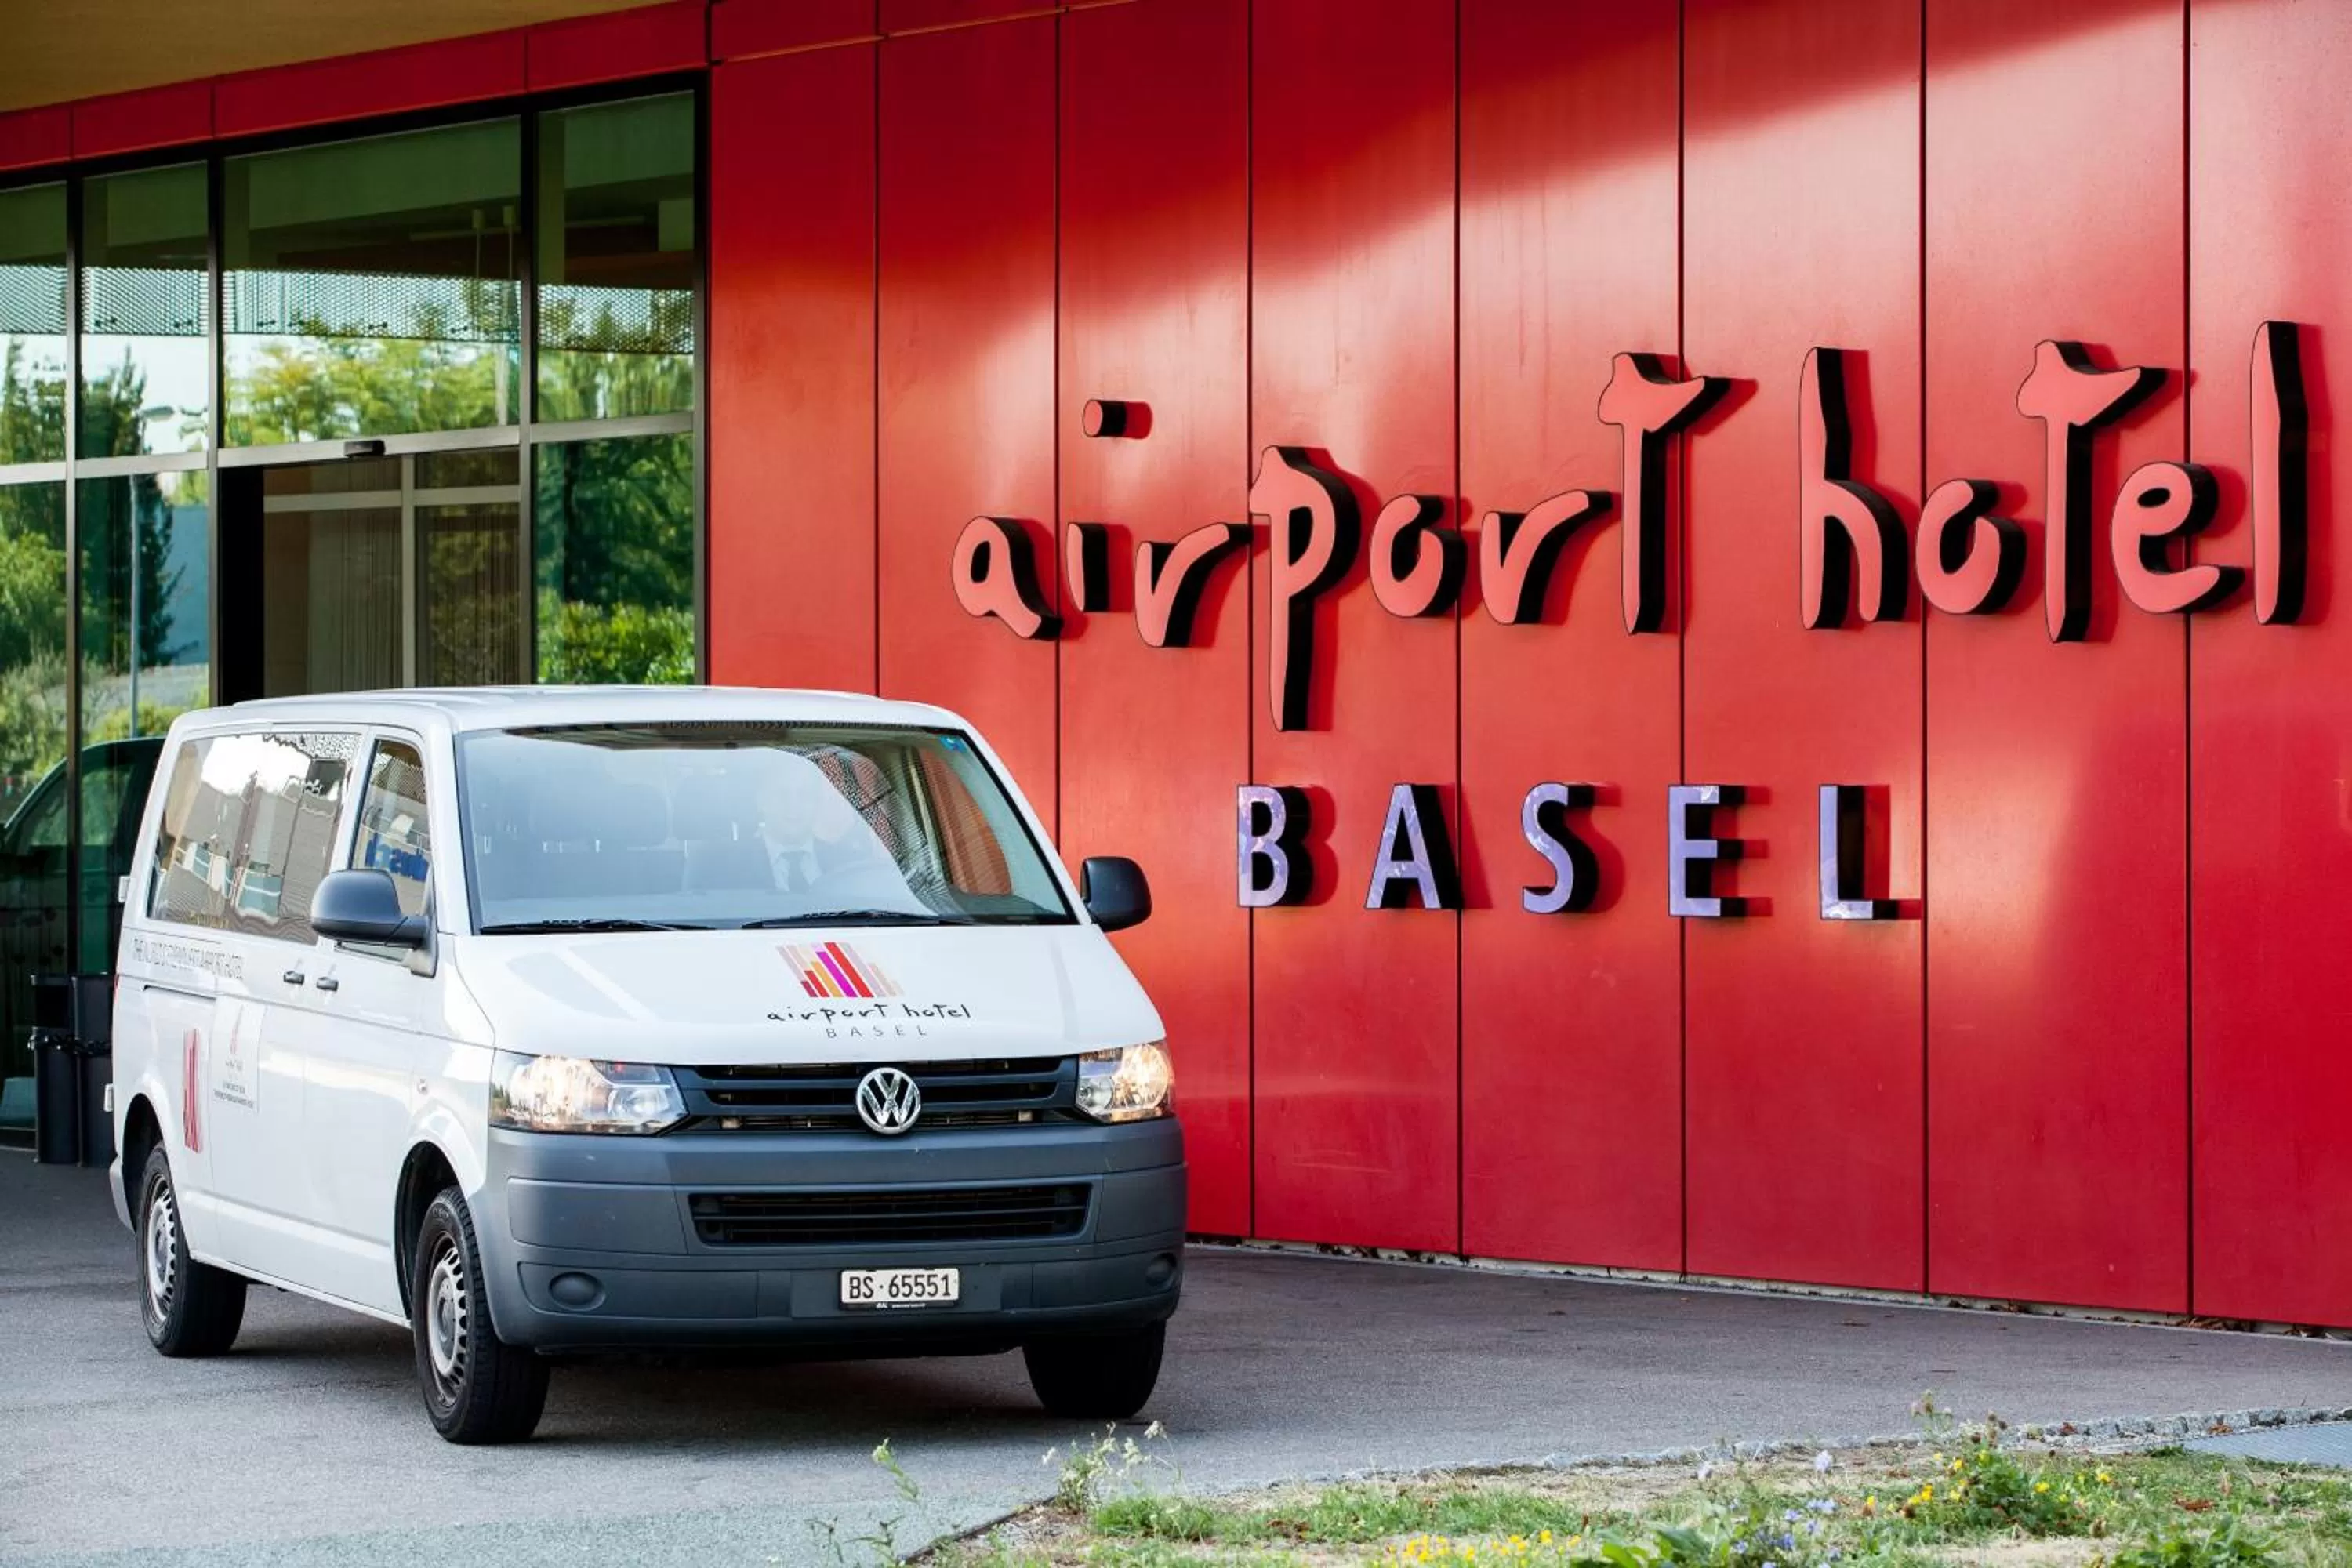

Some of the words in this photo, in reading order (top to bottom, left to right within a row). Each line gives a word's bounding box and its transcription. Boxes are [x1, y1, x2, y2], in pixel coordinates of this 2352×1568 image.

[952, 352, 1725, 731] airport
[1798, 321, 2305, 643] hotel
[1237, 782, 1886, 921] BASEL
[767, 1003, 887, 1023] airport
[902, 1003, 971, 1018] hotel
[825, 1025, 928, 1039] BASEL
